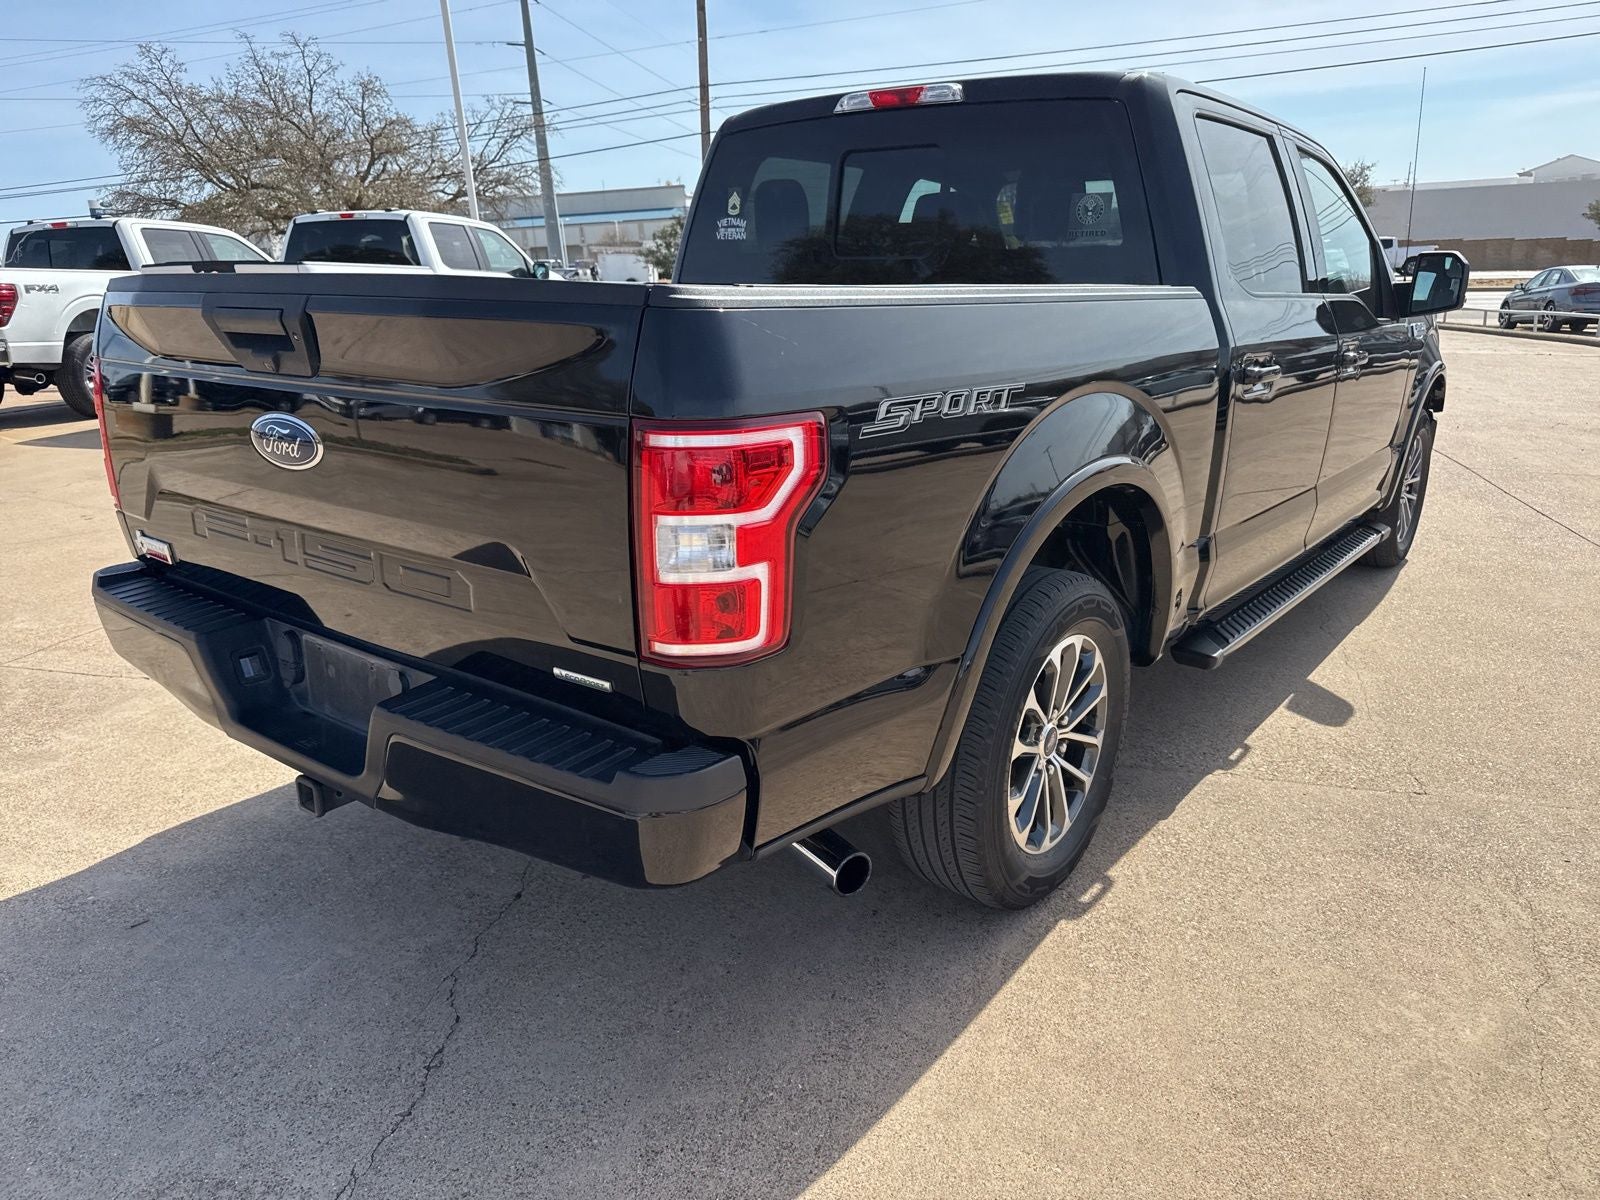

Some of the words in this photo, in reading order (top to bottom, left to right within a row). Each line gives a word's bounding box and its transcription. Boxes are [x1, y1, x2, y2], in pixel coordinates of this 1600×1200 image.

[716, 217, 747, 227] VIETNAM
[716, 231, 746, 240] VETERAN
[1068, 230, 1107, 238] RETIRED
[24, 284, 60, 295] FX4
[859, 382, 1026, 439] SPORT
[263, 424, 301, 458] Ford
[191, 505, 474, 613] F-150
